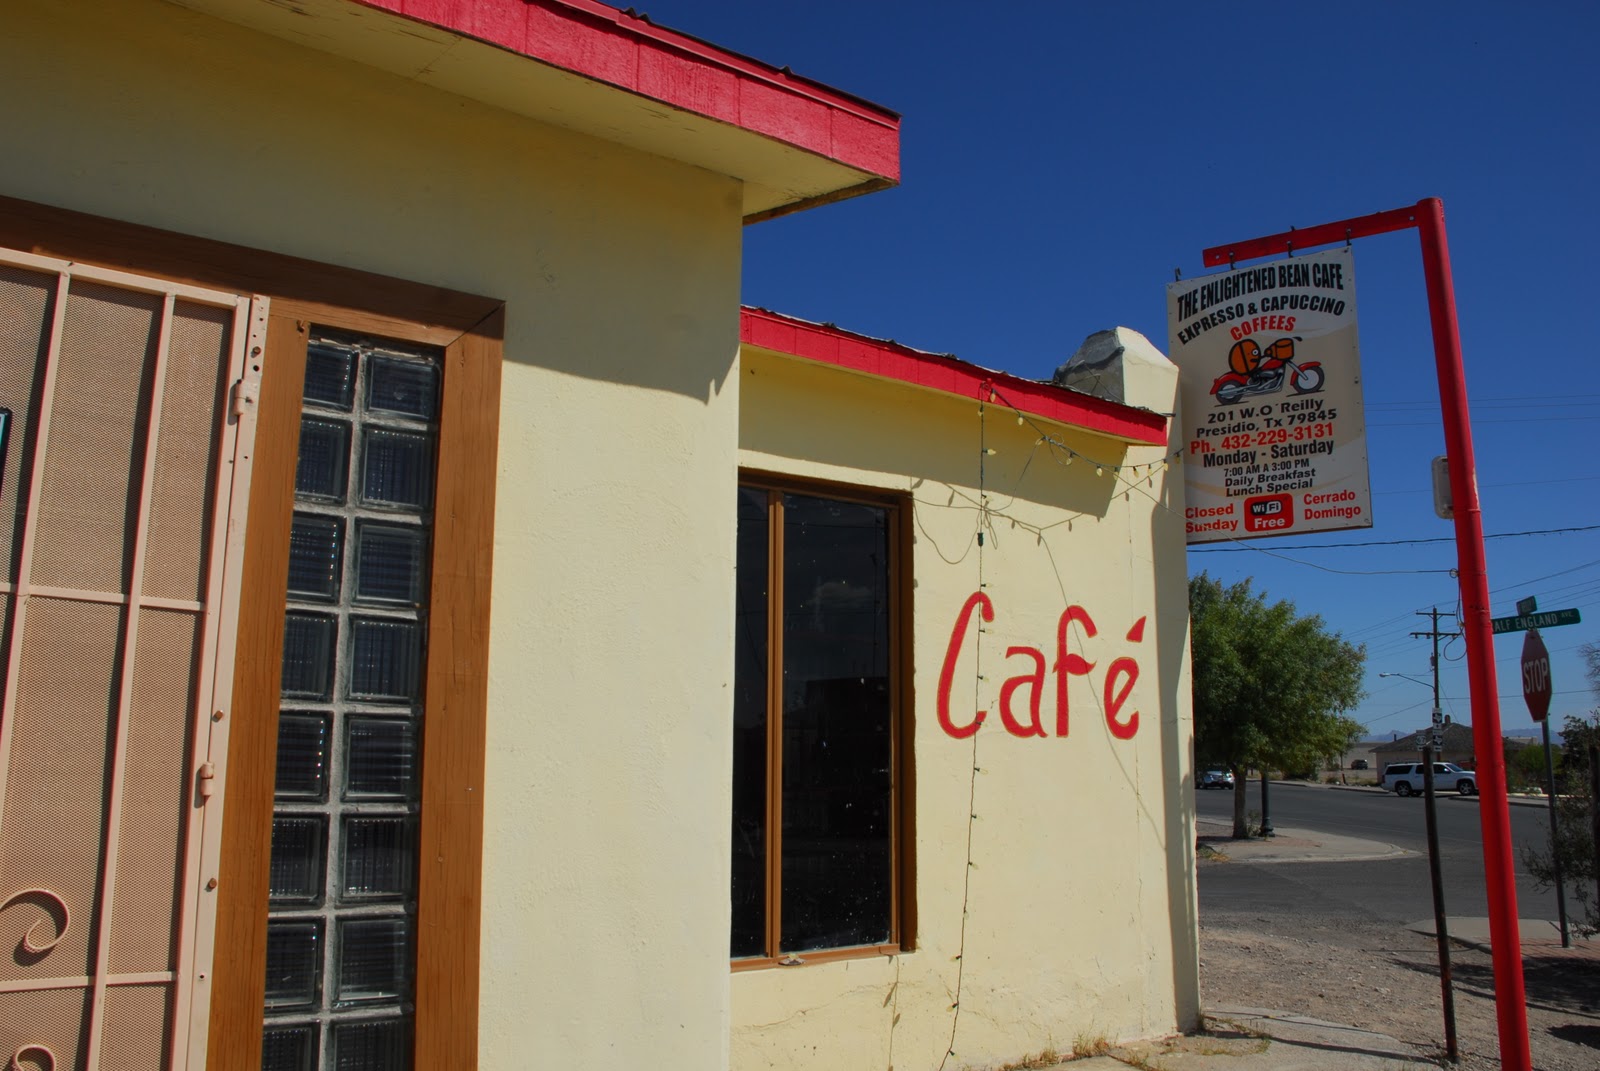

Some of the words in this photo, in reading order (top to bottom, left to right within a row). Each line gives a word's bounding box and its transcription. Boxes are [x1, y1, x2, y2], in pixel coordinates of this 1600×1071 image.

[1178, 288, 1198, 322] THE
[1200, 267, 1276, 311] ENLIGHTENED
[1279, 264, 1309, 288] BEAN
[1313, 263, 1344, 290] CAFE
[1177, 303, 1245, 345] EXPRESSO
[1248, 302, 1258, 315] &
[1261, 295, 1345, 316] CAPUCCINO
[1230, 315, 1296, 341] COFFEES
[1197, 423, 1260, 438] Presidio,
[1264, 418, 1282, 428] Tx
[1287, 409, 1337, 425] 79845
[1208, 411, 1234, 424] 201
[1190, 439, 1216, 454] Ph.
[1221, 422, 1333, 450] 432-229-3131
[1203, 450, 1257, 468] Monday
[1271, 440, 1334, 459] Saturday
[1224, 467, 1243, 477] 7:00
[1245, 464, 1260, 474] AM
[1263, 463, 1269, 472] A
[1272, 460, 1292, 471] 3:00
[1294, 458, 1310, 468] PM
[1225, 474, 1254, 487] Daily
[1258, 468, 1316, 483] Breakfast
[1226, 485, 1262, 497] Lunch
[1267, 479, 1313, 493] Special
[1304, 489, 1356, 505] Cerrado
[1185, 503, 1234, 519] Closed
[1304, 505, 1361, 520] Domingo
[1185, 519, 1238, 533] Sunday
[1254, 517, 1285, 529] Free
[1515, 613, 1558, 629] ENGLAND
[936, 590, 1147, 740] Café
[1523, 657, 1549, 694] STOP
